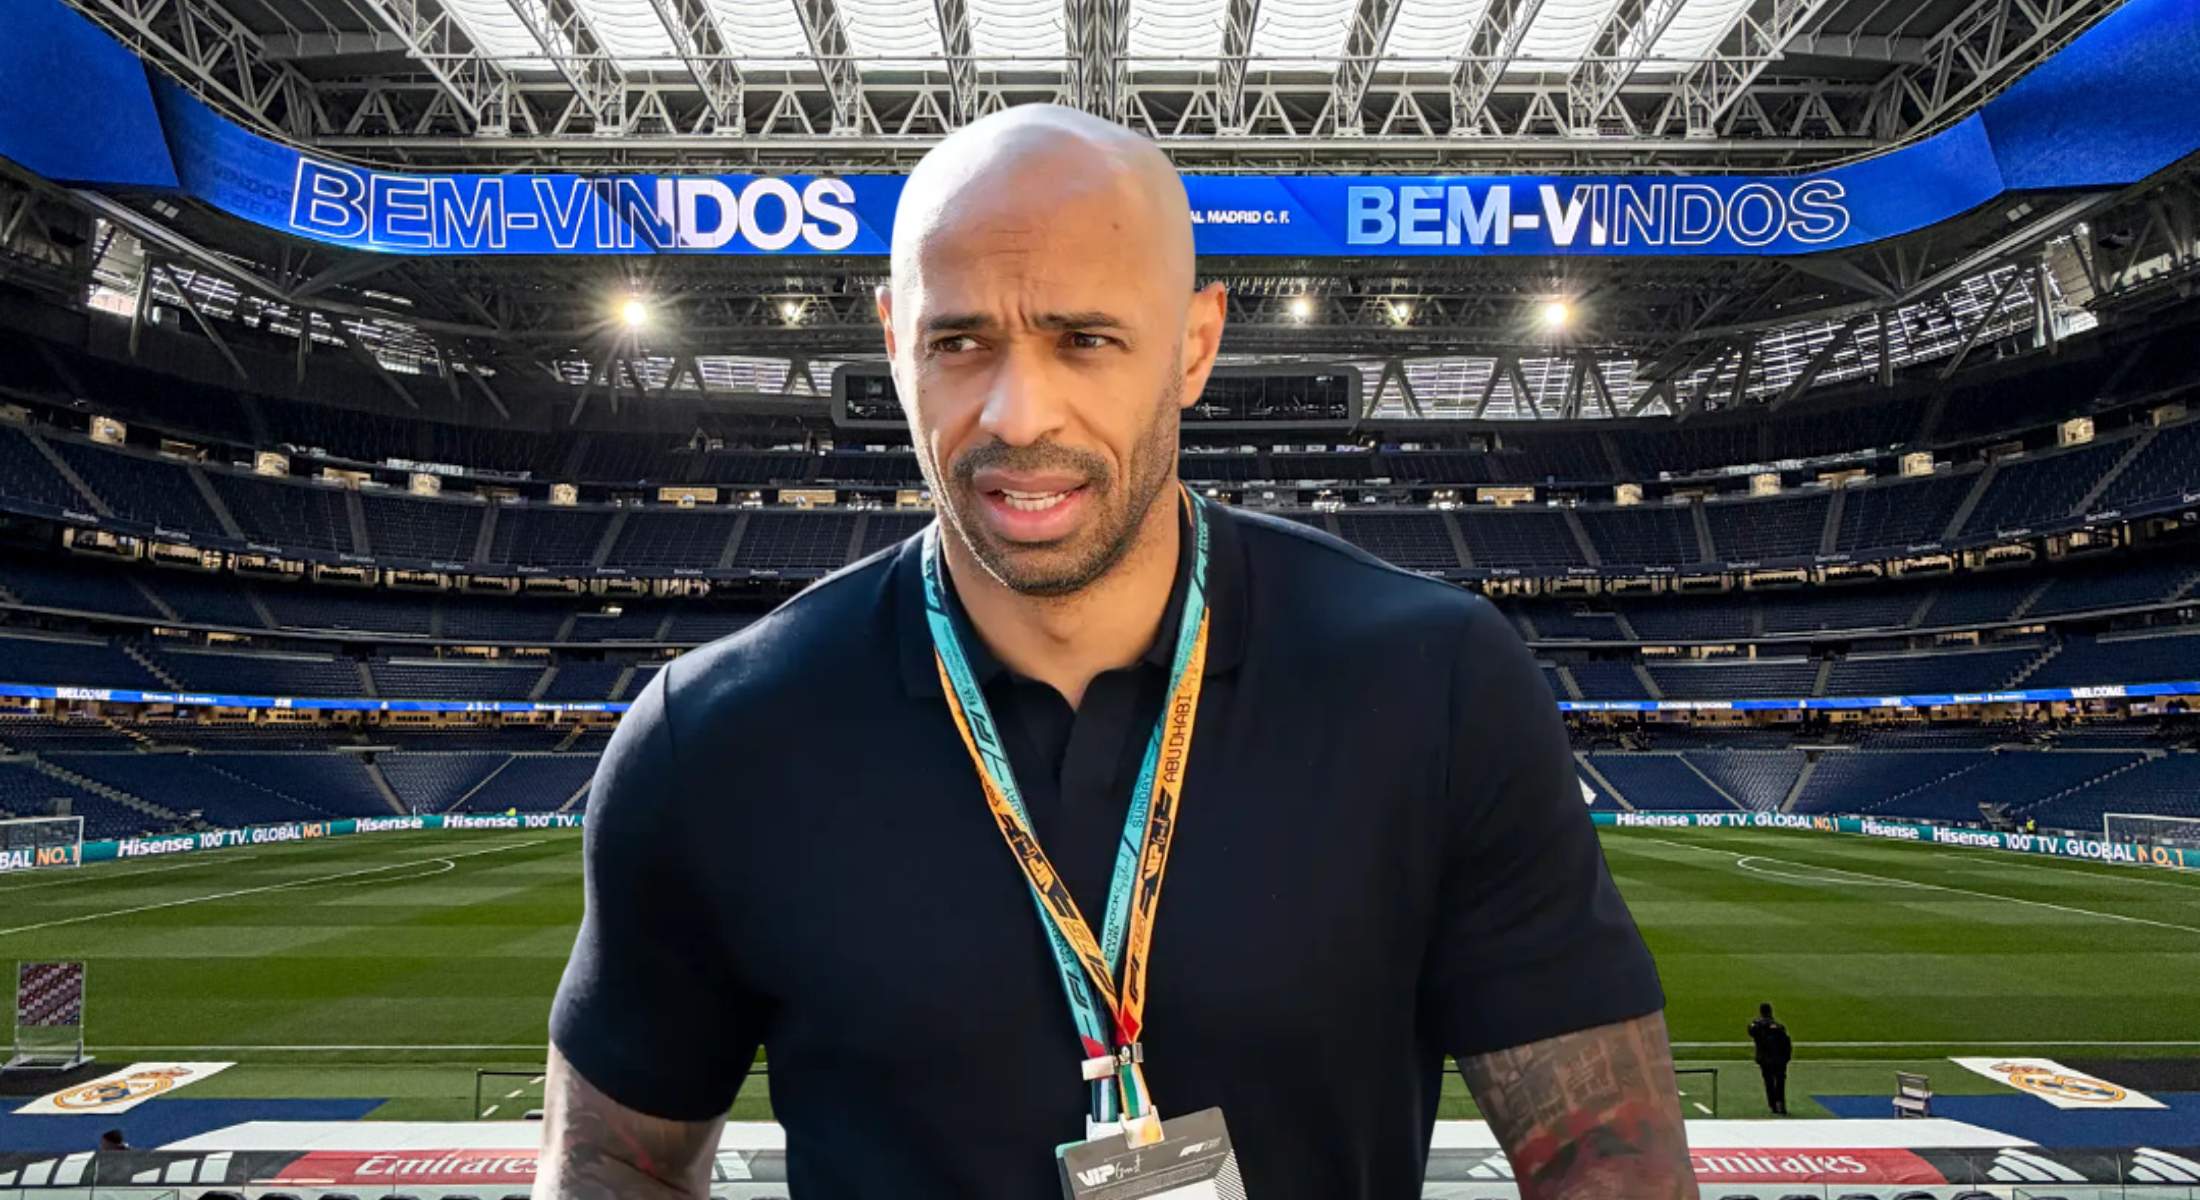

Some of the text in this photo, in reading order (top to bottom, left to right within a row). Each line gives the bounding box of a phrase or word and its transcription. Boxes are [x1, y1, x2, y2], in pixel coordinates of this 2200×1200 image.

[290, 157, 858, 250] BEM-VINDOS
[1347, 180, 1850, 246] BEM-VINDOS
[1207, 210, 1261, 224] MADRID
[2071, 685, 2126, 698] WELCOME
[1132, 773, 1152, 828] SUNDAY
[356, 817, 423, 832] Hisense
[444, 815, 518, 828] Hisense
[1617, 813, 1689, 826] Hisense
[1755, 813, 1813, 828] GLOBAL
[1861, 820, 1919, 839] Hisense
[117, 838, 194, 857] Hisense
[252, 824, 301, 843] GLOBAL
[1932, 826, 2000, 848] Hisense
[2066, 840, 2136, 862] GLOBAL
[1144, 843, 1163, 880] VIP
[1077, 1163, 1116, 1187] VIP
